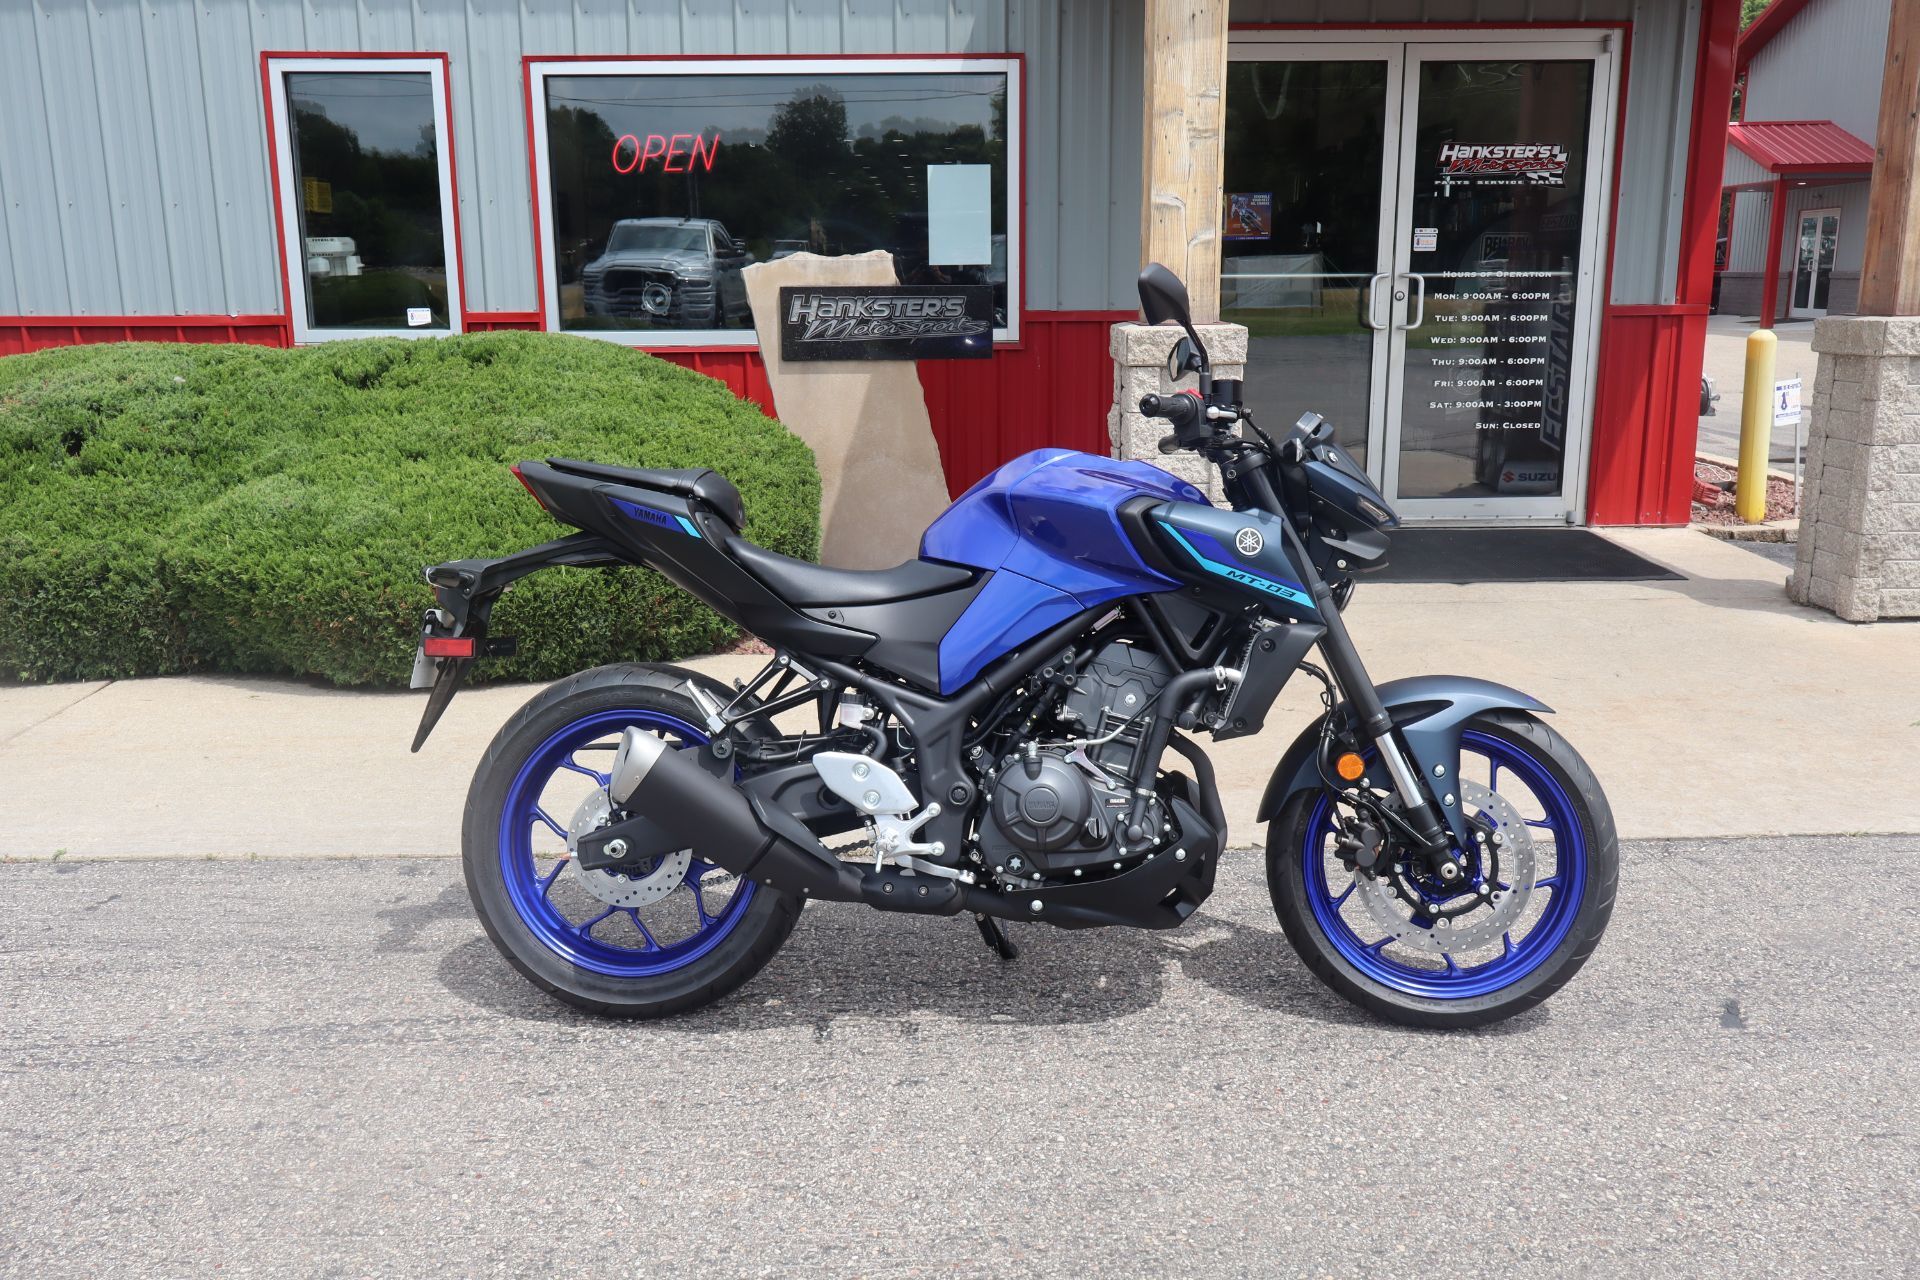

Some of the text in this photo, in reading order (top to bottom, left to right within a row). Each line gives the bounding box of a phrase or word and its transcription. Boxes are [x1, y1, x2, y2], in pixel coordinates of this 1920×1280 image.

[612, 134, 720, 174] OPEN
[1511, 292, 1550, 300] 6:00PM
[1461, 314, 1500, 322] 9:00AM
[1510, 314, 1548, 322] 6:00PM
[1459, 336, 1499, 344] 9:00AM
[1508, 335, 1547, 343] 6:00PM
[1458, 358, 1497, 366] 9:00AM
[1507, 357, 1545, 365] 6:00PM
[1456, 379, 1496, 387] 9:00AM
[1505, 379, 1544, 387] 6:00PM
[1455, 400, 1494, 409] 9:00AM
[1504, 400, 1542, 408] 3:00PM
[633, 507, 667, 525] YAMAHA
[1226, 570, 1296, 599] MT-03
